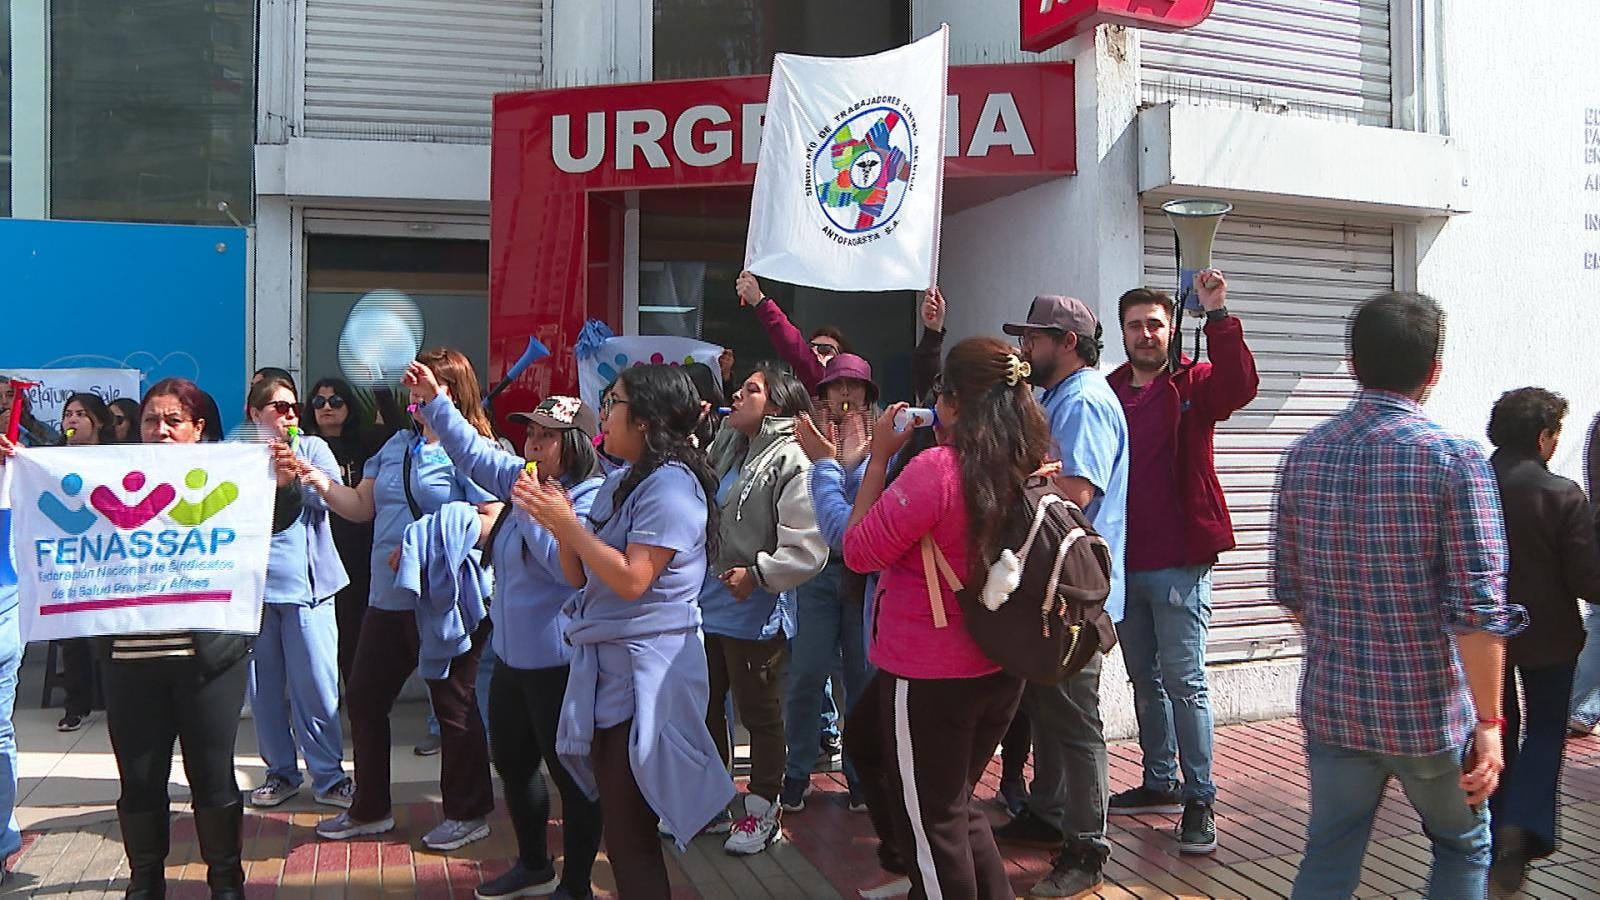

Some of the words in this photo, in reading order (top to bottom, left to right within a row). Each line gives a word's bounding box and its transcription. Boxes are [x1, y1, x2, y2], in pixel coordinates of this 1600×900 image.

[818, 125, 832, 139] DE
[834, 95, 901, 121] TRABAJADORES
[822, 225, 880, 247] ANTOFAGASTA
[35, 527, 236, 567] FENASSAP
[97, 562, 149, 578] Nacional
[150, 560, 167, 574] de
[51, 586, 65, 599] de
[79, 583, 111, 597] Salud
[159, 580, 168, 592] y
